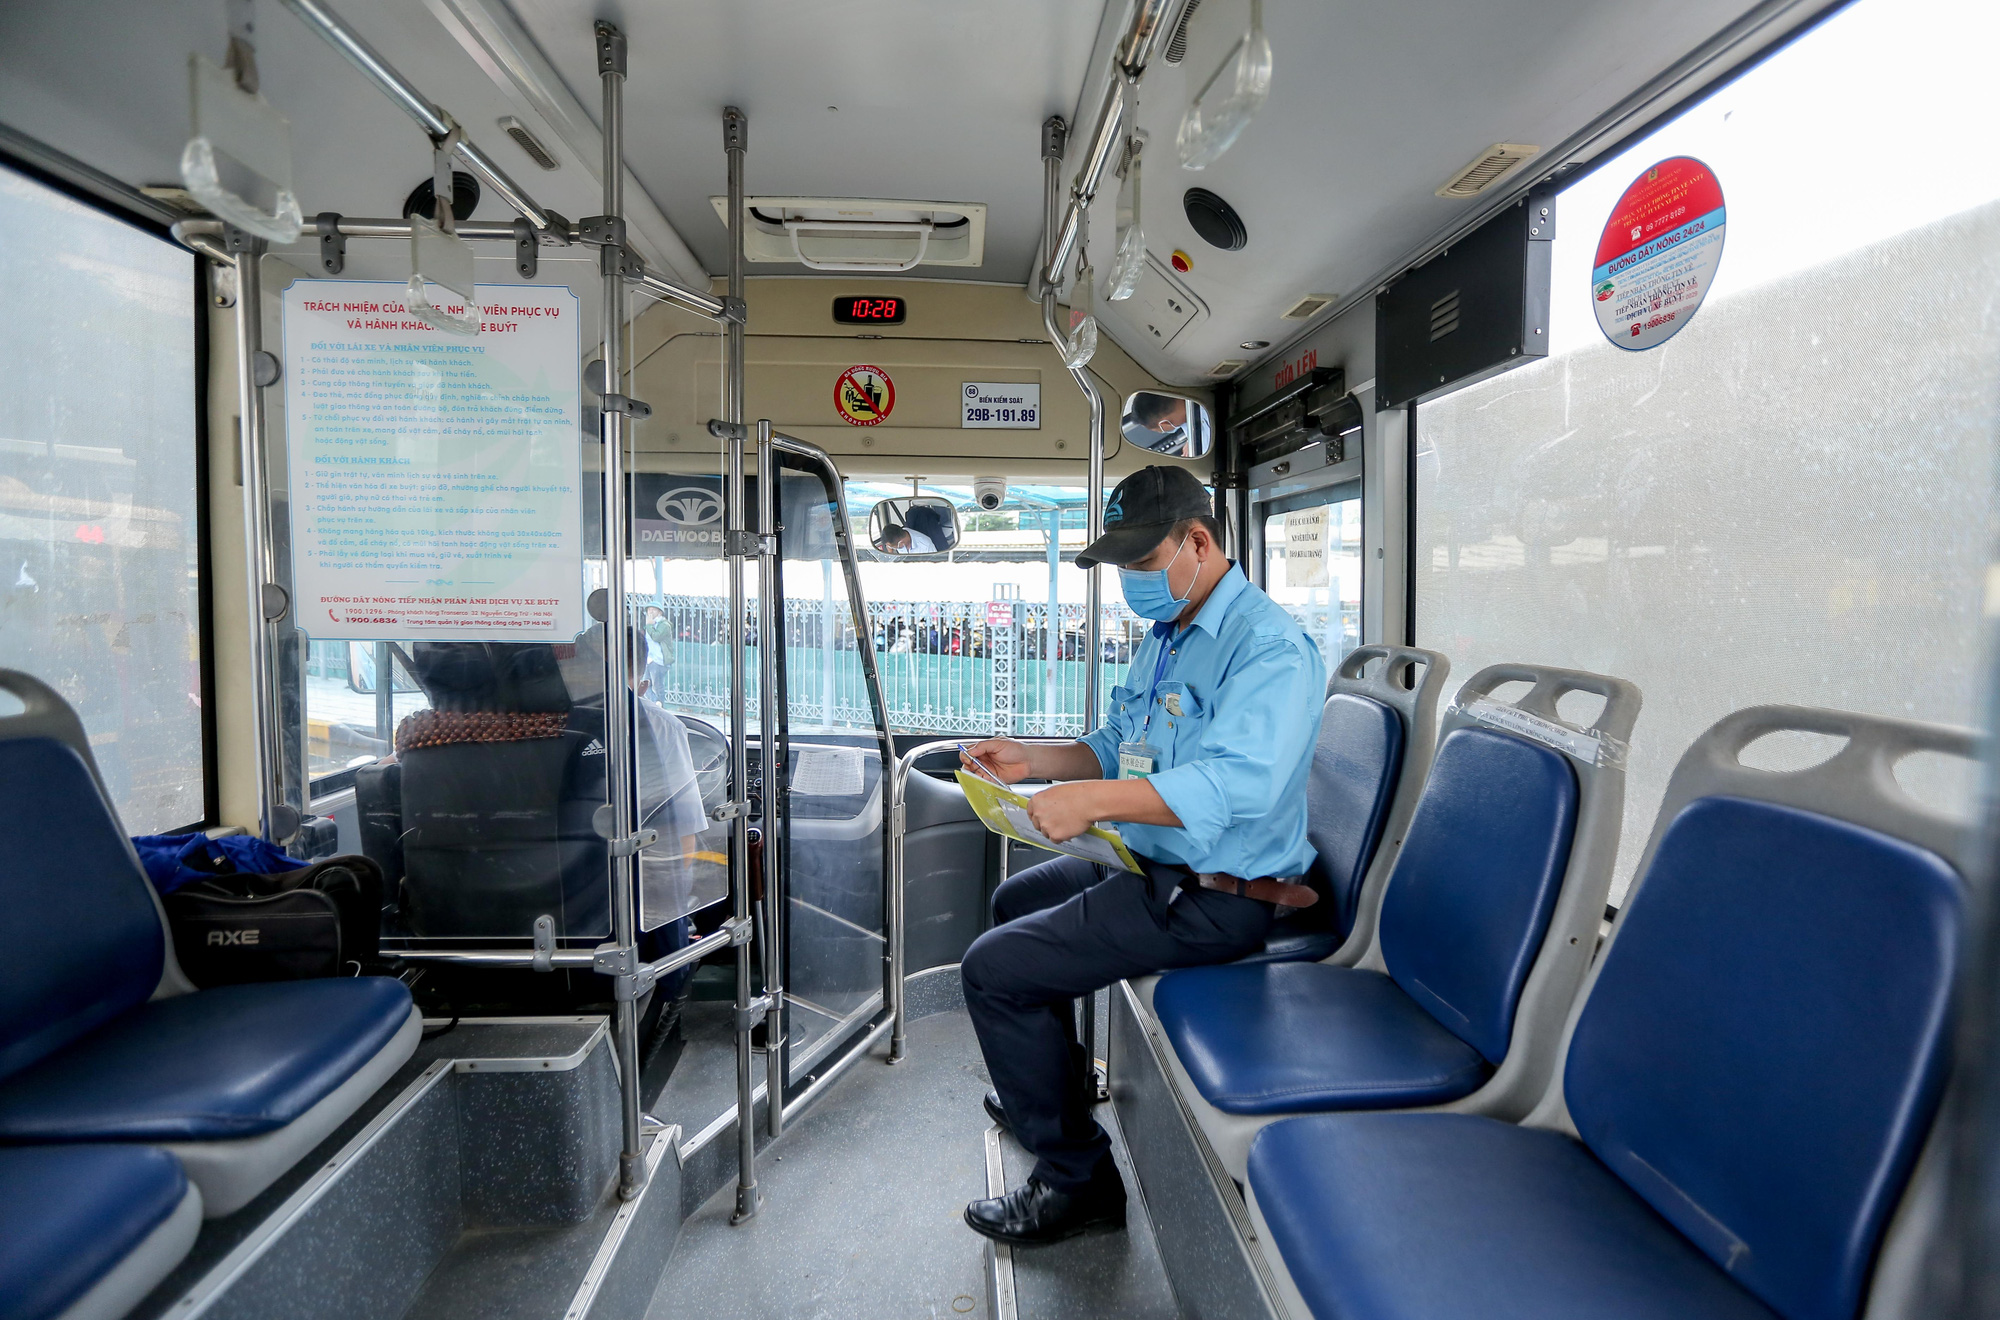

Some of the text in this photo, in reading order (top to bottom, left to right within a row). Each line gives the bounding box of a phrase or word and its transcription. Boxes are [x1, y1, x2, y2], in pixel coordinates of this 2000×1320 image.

[1655, 215, 1669, 227] 7777
[1608, 254, 1637, 274] ĐƯỜNG
[1638, 245, 1655, 260] DÂY
[1656, 232, 1681, 251] NÓNG
[1683, 221, 1705, 238] 24/24
[304, 300, 340, 312] TRÁCH
[344, 301, 379, 315] NHIỆM
[382, 301, 405, 313] CỦA
[483, 304, 508, 315] VIÊN
[511, 307, 541, 318] PHỤC
[544, 308, 559, 319] VỤ
[852, 300, 897, 318] 10:28
[347, 318, 362, 329] VÀ
[366, 318, 398, 330] HÀNH
[490, 321, 518, 332] BUÝT
[311, 341, 328, 350] ĐỐI
[329, 342, 346, 350] VỚI
[347, 342, 364, 350] LÁI
[379, 343, 392, 351] VÀ
[394, 343, 420, 351] NHÂN
[422, 344, 444, 352] VIÊN
[446, 346, 470, 354] PHỤC
[472, 346, 486, 355] VỤ
[967, 408, 1035, 422] 29B-191.89
[315, 455, 411, 464] ĐỐI VỚI HÀNH KHÁCH
[642, 530, 709, 542] DAEWOO
[418, 596, 443, 605] NHẬN
[208, 930, 259, 946] AXE
